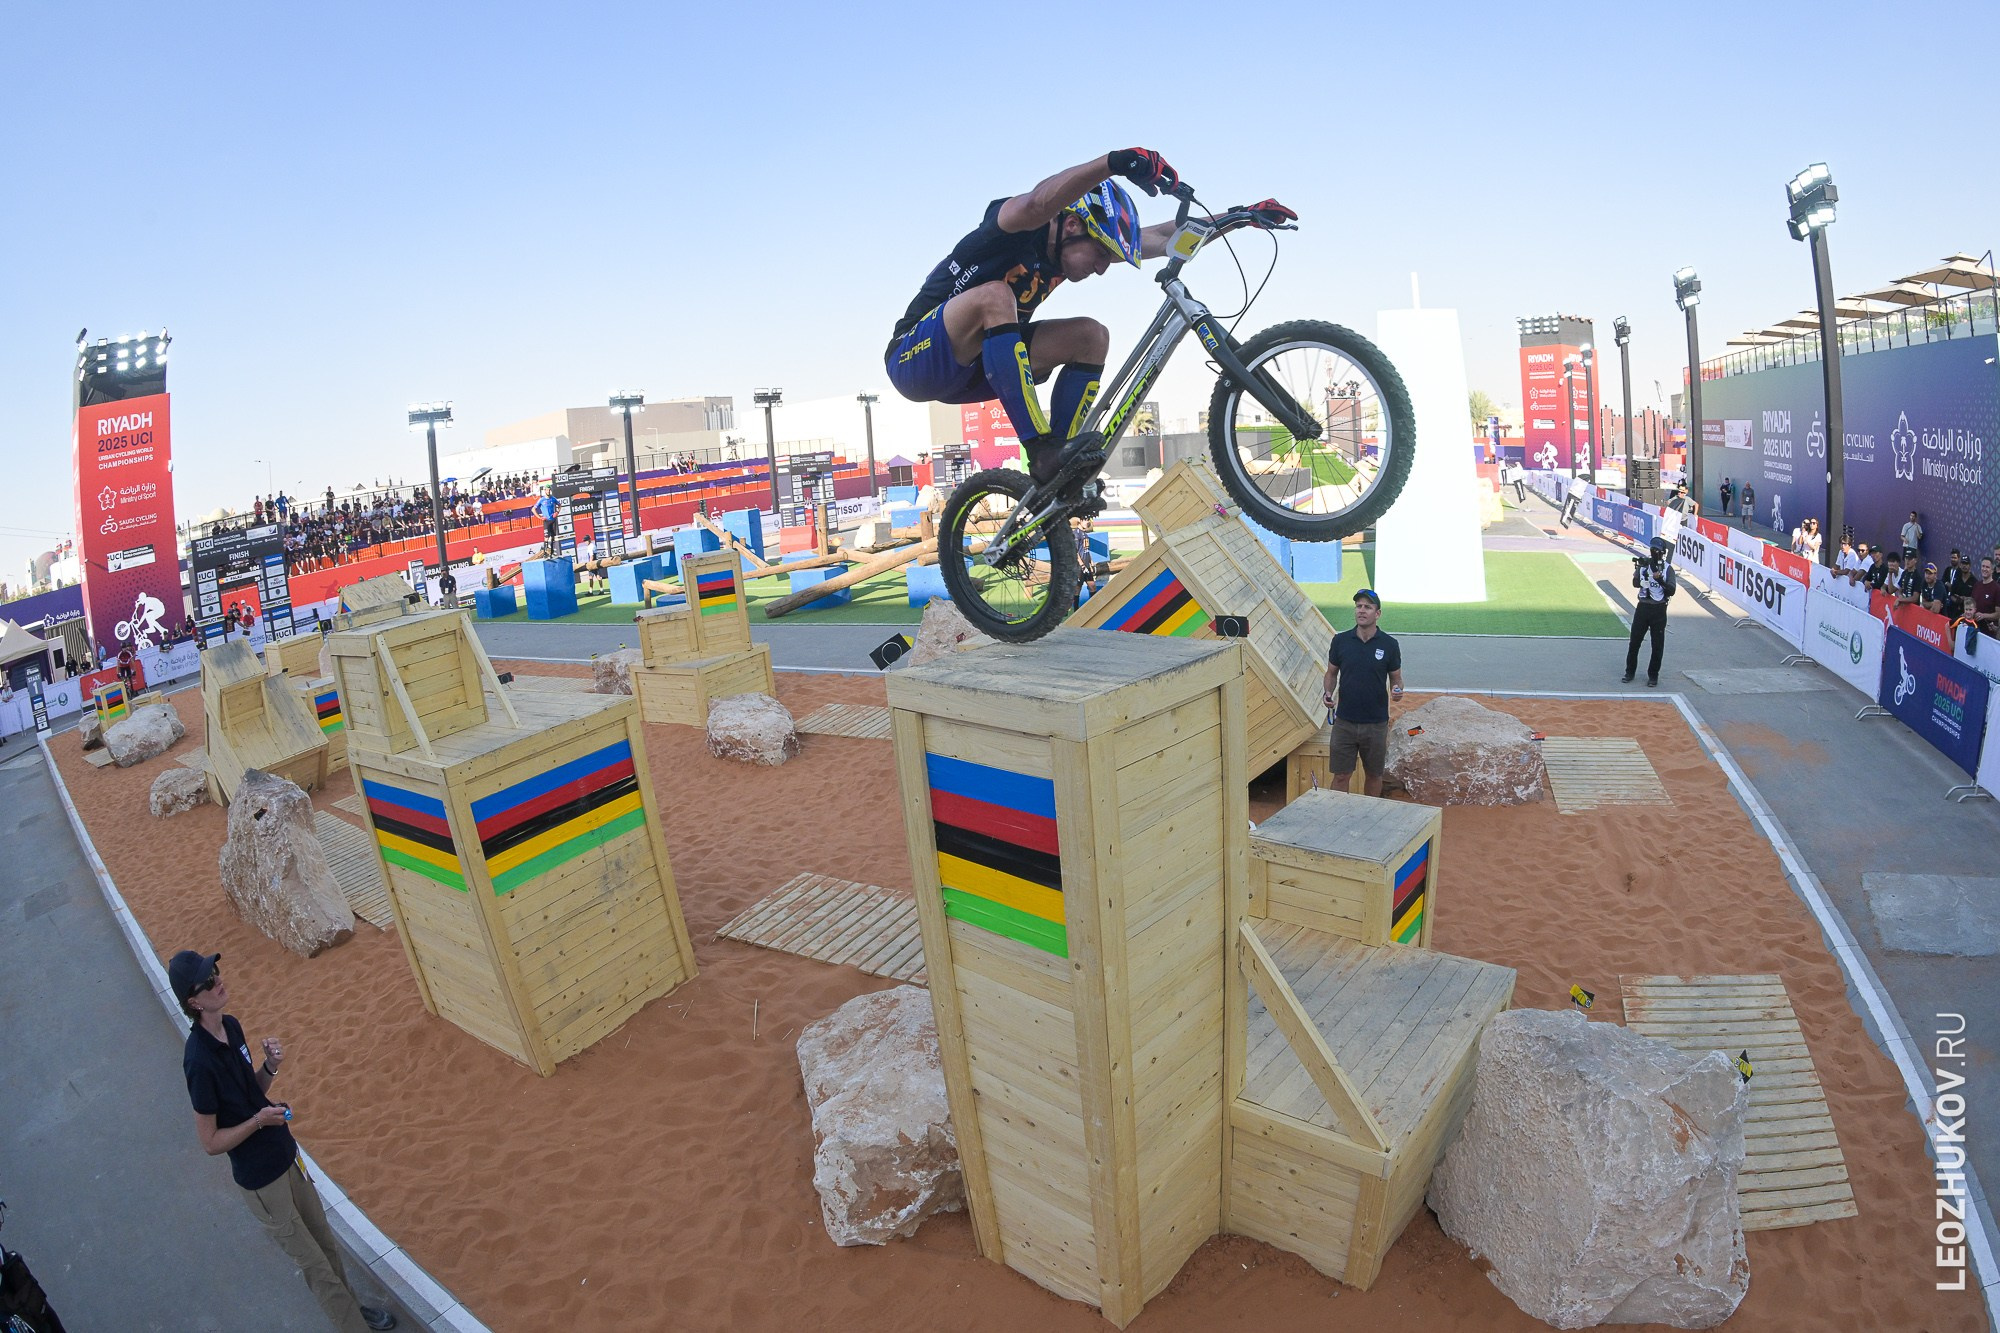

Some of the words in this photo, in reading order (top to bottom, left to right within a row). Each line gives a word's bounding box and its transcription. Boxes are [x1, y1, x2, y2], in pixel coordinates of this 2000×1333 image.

[1100, 181, 1115, 218] COMAS
[1199, 323, 1217, 350] WD-40
[1528, 354, 1554, 363] RIYADH
[98, 411, 152, 436] RIYADH
[1763, 411, 1791, 433] RIYADH
[98, 435, 128, 452] 2025
[131, 431, 153, 446] UCI
[1763, 439, 1778, 457] 2025
[1780, 440, 1792, 458] UCI
[1846, 434, 1874, 449] CYCLING
[1923, 428, 1954, 457] الرياضة
[1957, 428, 1982, 461] وزارة
[98, 453, 115, 461] URBAN
[115, 450, 136, 458] CYCLING
[136, 447, 154, 455] WORLD
[99, 454, 154, 470] CHAMPIONSHIPS
[1764, 470, 1792, 484] CHAMPIONSHIPS
[1922, 458, 1948, 483] Ministry
[1950, 464, 1959, 481] of
[1959, 463, 1982, 487] Sport
[120, 485, 140, 496] الرياضة
[141, 483, 156, 493] وزارة
[120, 496, 137, 504] Ministry
[143, 491, 156, 501] Sport
[572, 503, 594, 513] 15:03:11
[837, 504, 863, 515] TISSOT
[119, 518, 135, 526] SAUDI
[136, 513, 157, 522] CYCLING
[200, 539, 213, 549] UCI
[110, 552, 122, 561] UCI
[229, 550, 250, 560] FINISH
[449, 562, 470, 571] YCLING
[1789, 565, 1804, 579] RIYADH
[201, 571, 214, 580] UCI
[416, 573, 422, 583] 2
[1735, 560, 1786, 616] TISSOT
[279, 629, 292, 639] UCI
[1916, 624, 1942, 647] RIYADH
[32, 682, 38, 694] 1
[1936, 673, 1967, 705] RIYADH
[1934, 692, 1951, 712] 2025
[1951, 703, 1964, 723] UCI
[1931, 714, 1960, 740] CHAMPIONSHIPS
